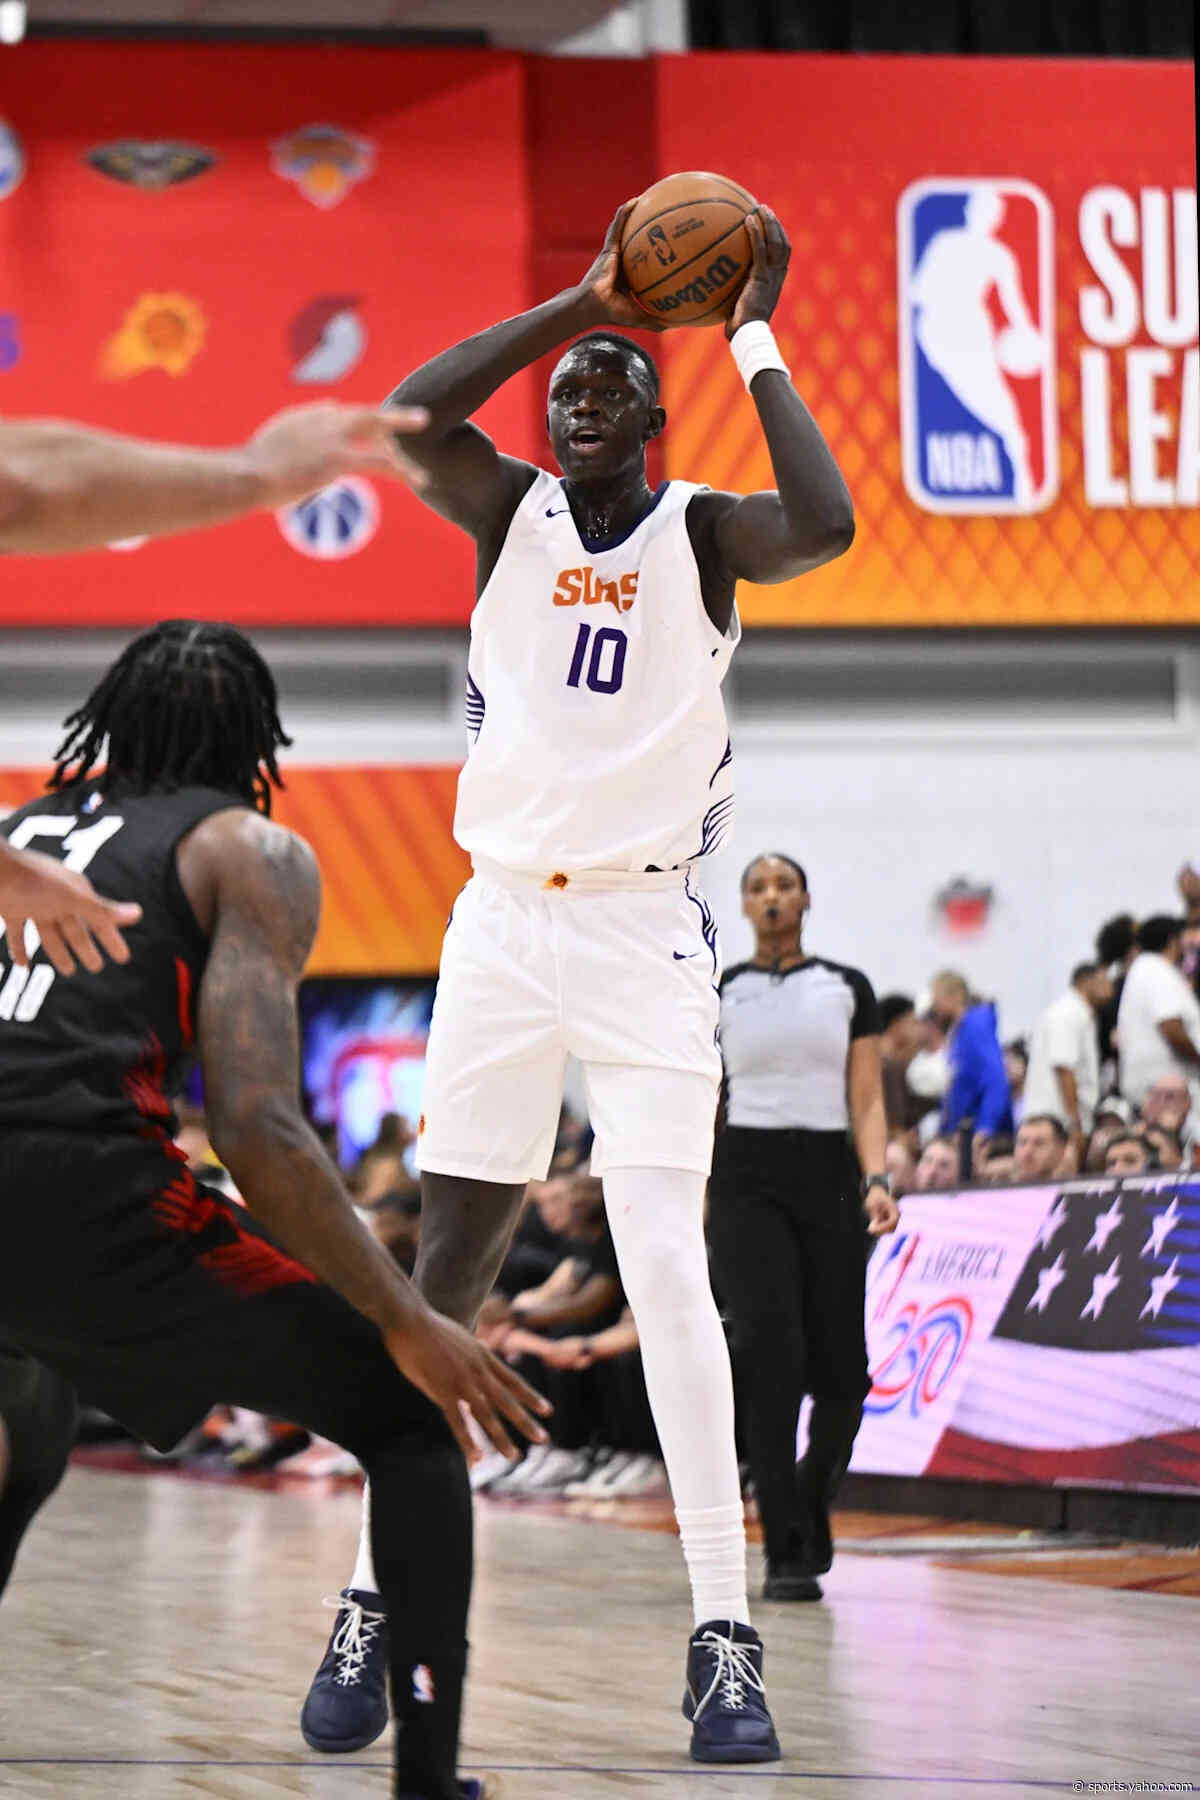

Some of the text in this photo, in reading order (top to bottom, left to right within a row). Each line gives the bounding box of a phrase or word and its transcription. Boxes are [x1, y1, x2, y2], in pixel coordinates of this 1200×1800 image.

[1078, 185, 1199, 347] SU
[926, 432, 1003, 491] NBA
[566, 622, 628, 695] 10
